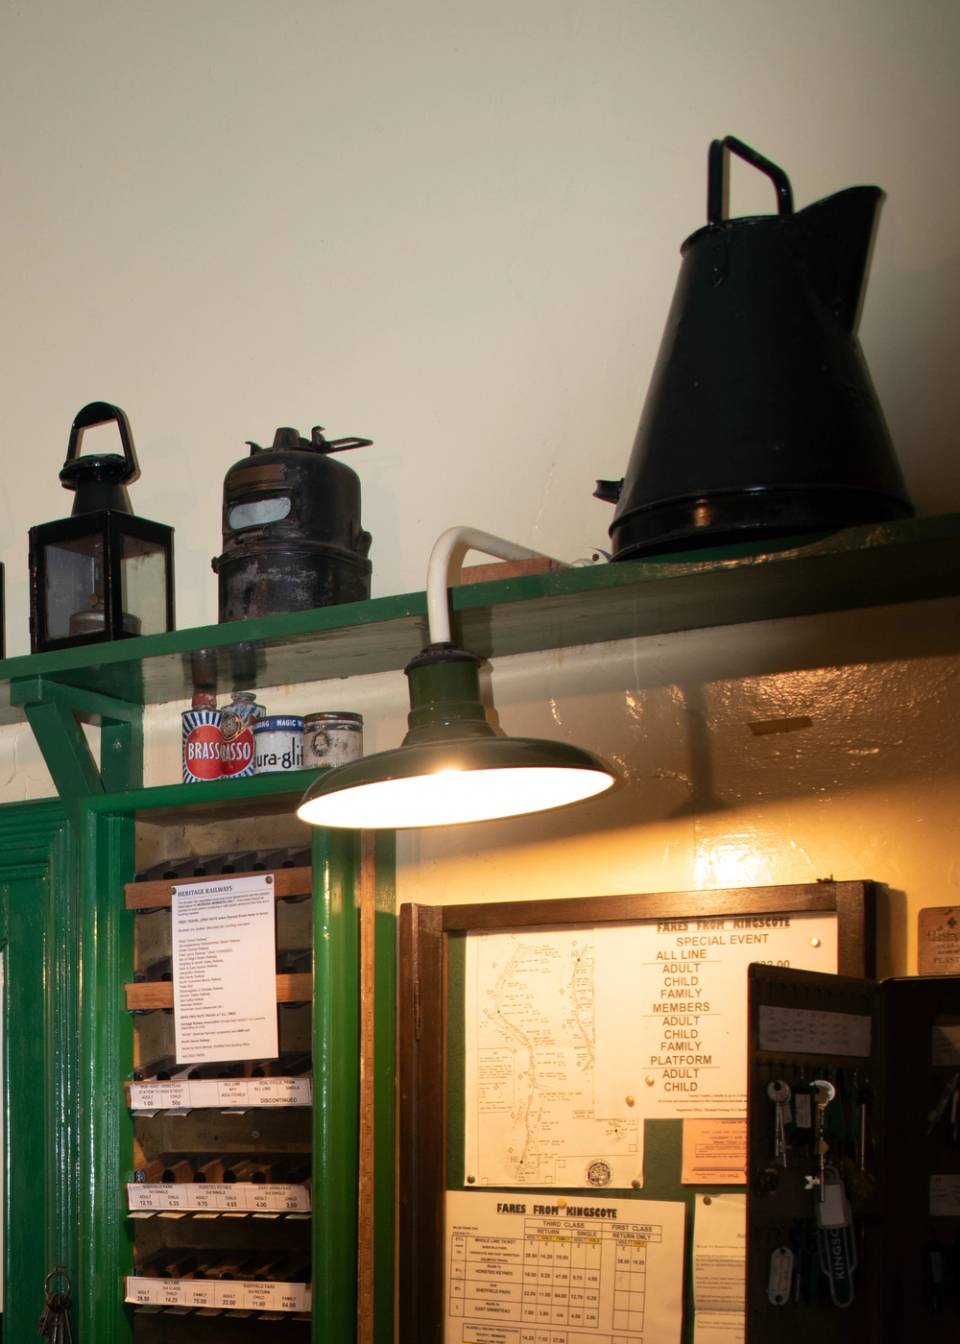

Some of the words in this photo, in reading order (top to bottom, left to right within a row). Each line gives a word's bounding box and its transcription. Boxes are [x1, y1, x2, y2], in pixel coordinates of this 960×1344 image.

[276, 719, 297, 728] MAGIC
[177, 888, 204, 897] HERITAGE
[205, 885, 233, 894] RAILWAYS
[733, 917, 790, 929] KINGSCOTE
[676, 936, 726, 947] SPECIAL
[730, 933, 769, 945] EVENT
[656, 951, 677, 960] ALL
[681, 949, 707, 959] LINE
[662, 963, 700, 974] ADULT
[664, 976, 699, 987] CHILD
[660, 989, 702, 999] FAMILY
[652, 1002, 711, 1013] MEMBERS
[662, 1016, 700, 1026] ADULT
[664, 1029, 698, 1040] CHILD
[660, 1041, 702, 1051] FAMILY
[650, 1055, 712, 1065] PLATFORM
[662, 1068, 700, 1079] ADULT
[664, 1082, 698, 1092] CHILD
[497, 1202, 527, 1214] FARES
[533, 1204, 559, 1215] FROM
[566, 1206, 617, 1219] KINGSCOTE
